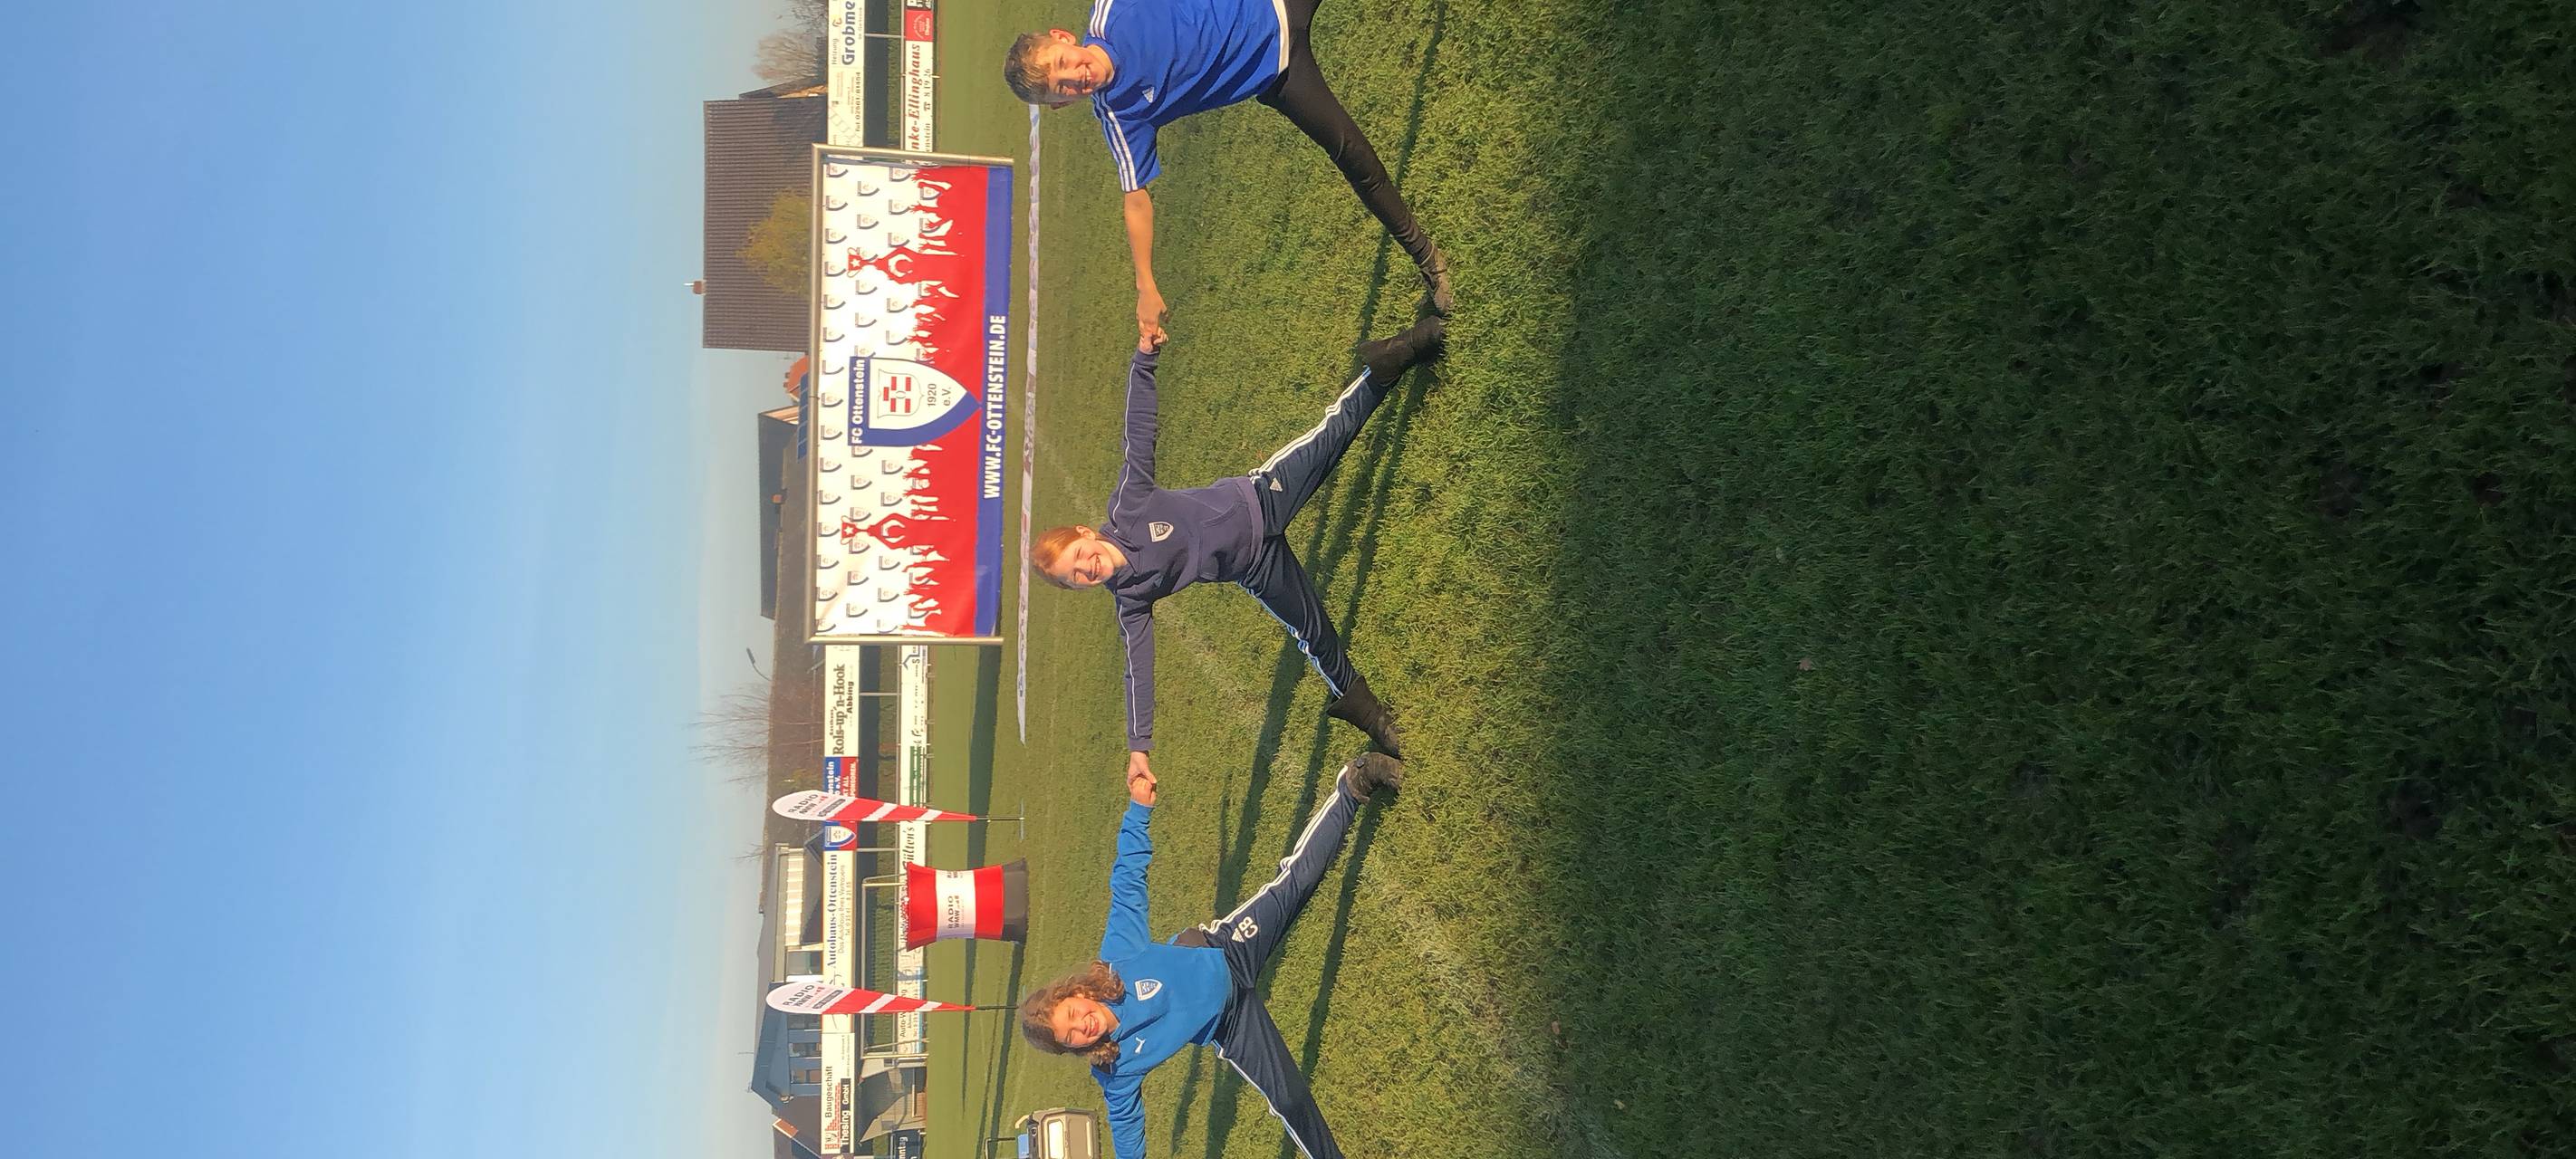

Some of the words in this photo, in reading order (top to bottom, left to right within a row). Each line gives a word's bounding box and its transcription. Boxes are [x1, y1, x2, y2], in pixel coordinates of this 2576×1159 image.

[841, 0, 855, 65] Grobme
[852, 359, 865, 425] Ottenstein
[928, 384, 937, 407] 1920
[942, 387, 951, 407] e.V.
[984, 315, 1005, 499] WWW.FC-OTTENSTEIN.DE
[851, 427, 862, 444] FC
[846, 681, 854, 714] Abbing
[787, 794, 819, 813] RADIO
[826, 854, 837, 967] Autohaus-Ottenstein
[1239, 916, 1258, 939] CB
[782, 984, 815, 1006] RADIO
[824, 1066, 833, 1118] Baugeschäft
[841, 1110, 851, 1146] Thesing
